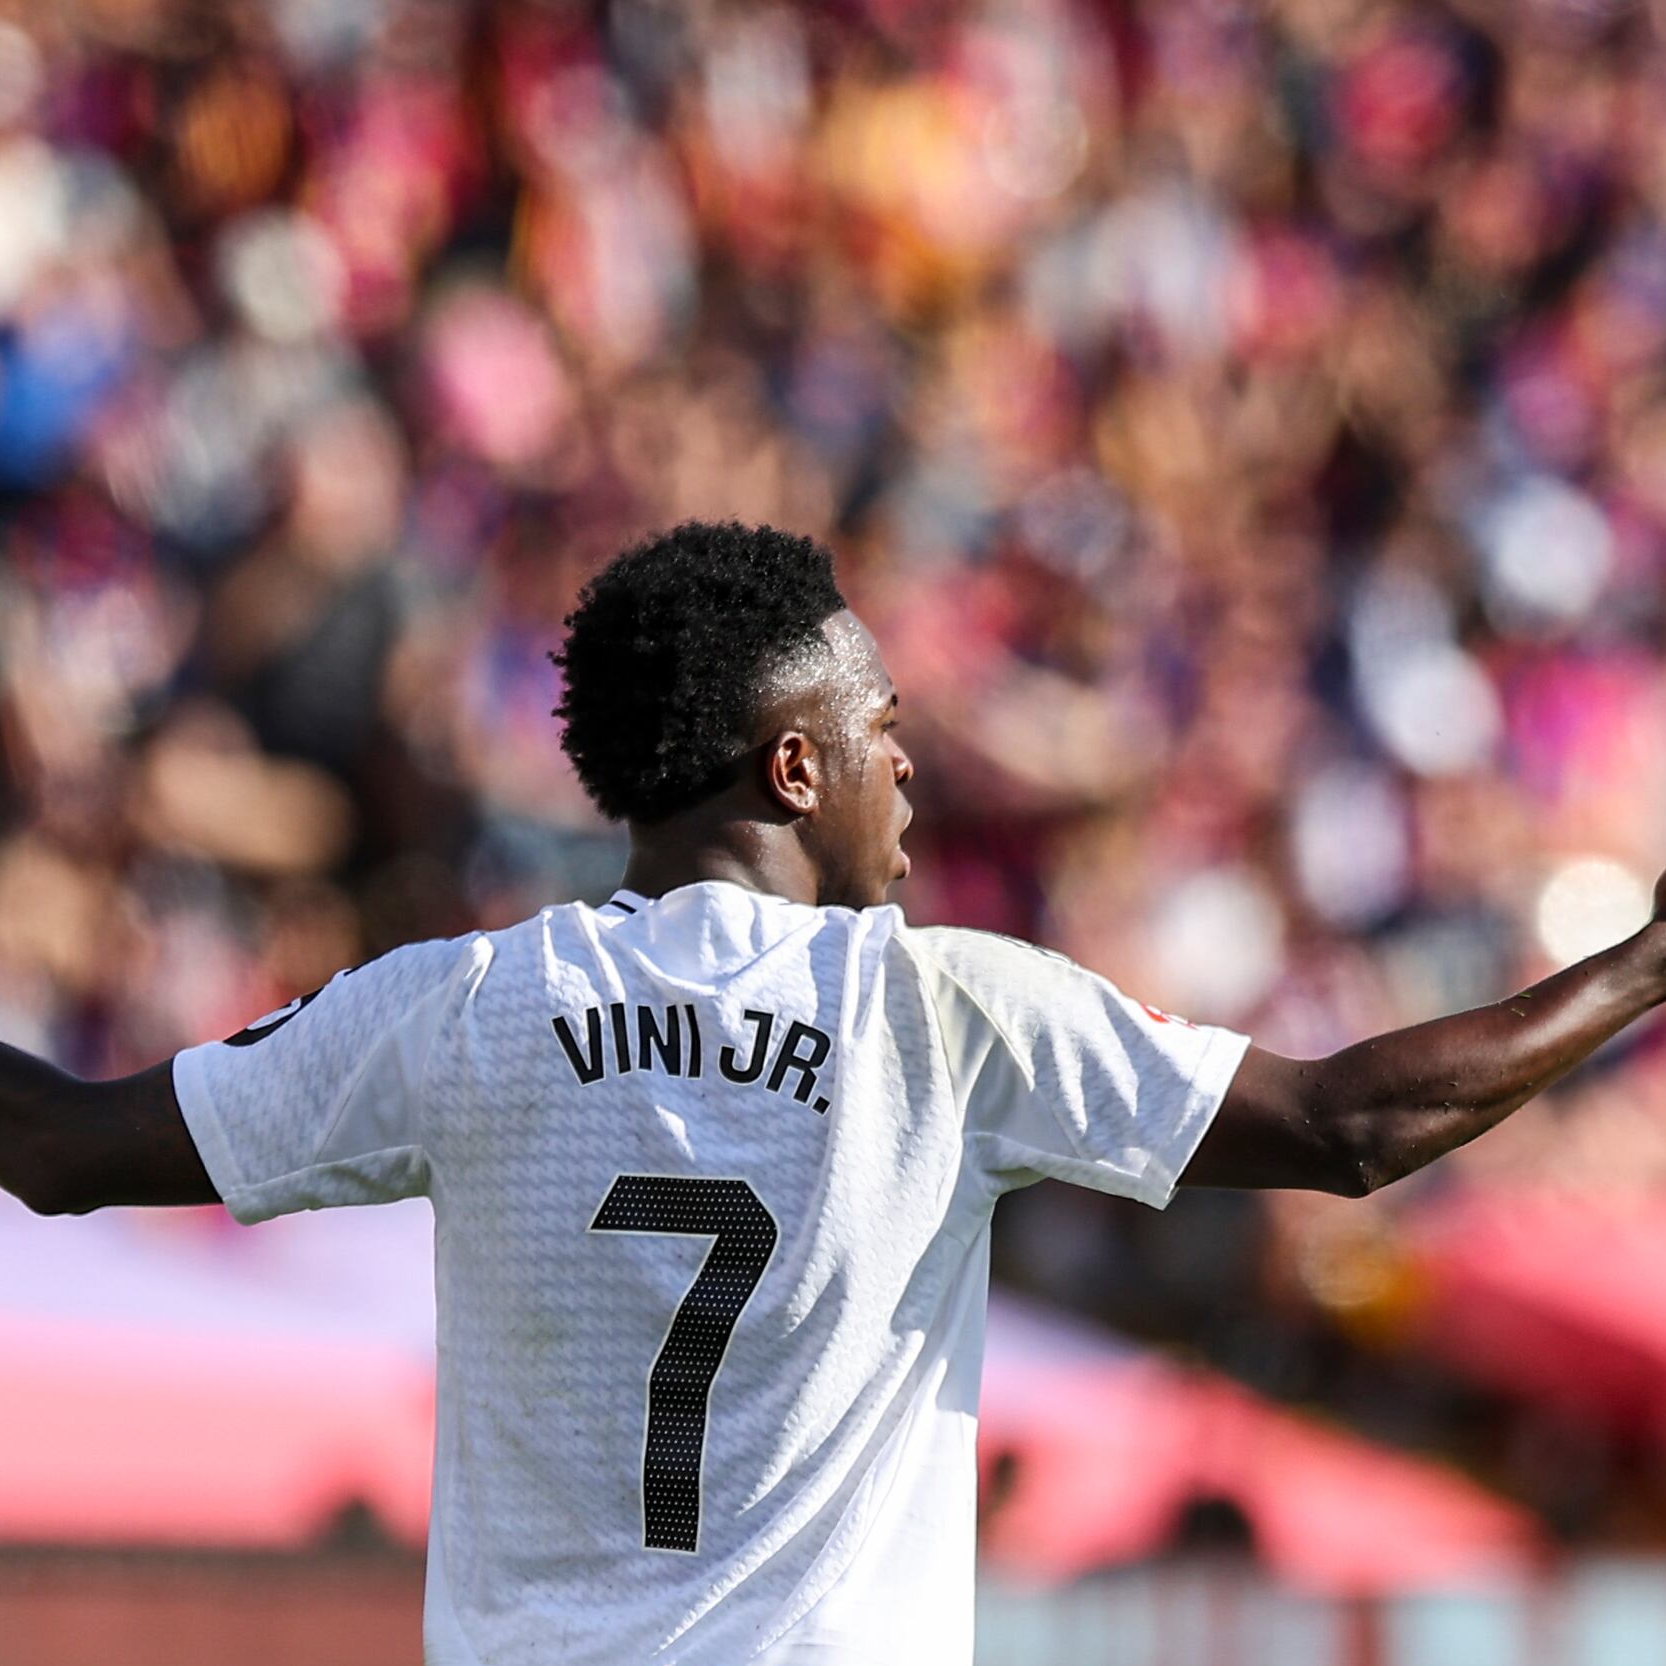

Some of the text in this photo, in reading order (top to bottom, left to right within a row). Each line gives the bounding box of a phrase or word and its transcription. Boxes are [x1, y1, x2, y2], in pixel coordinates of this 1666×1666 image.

[551, 1002, 832, 1116] VINI JR.
[588, 1174, 780, 1554] 7
